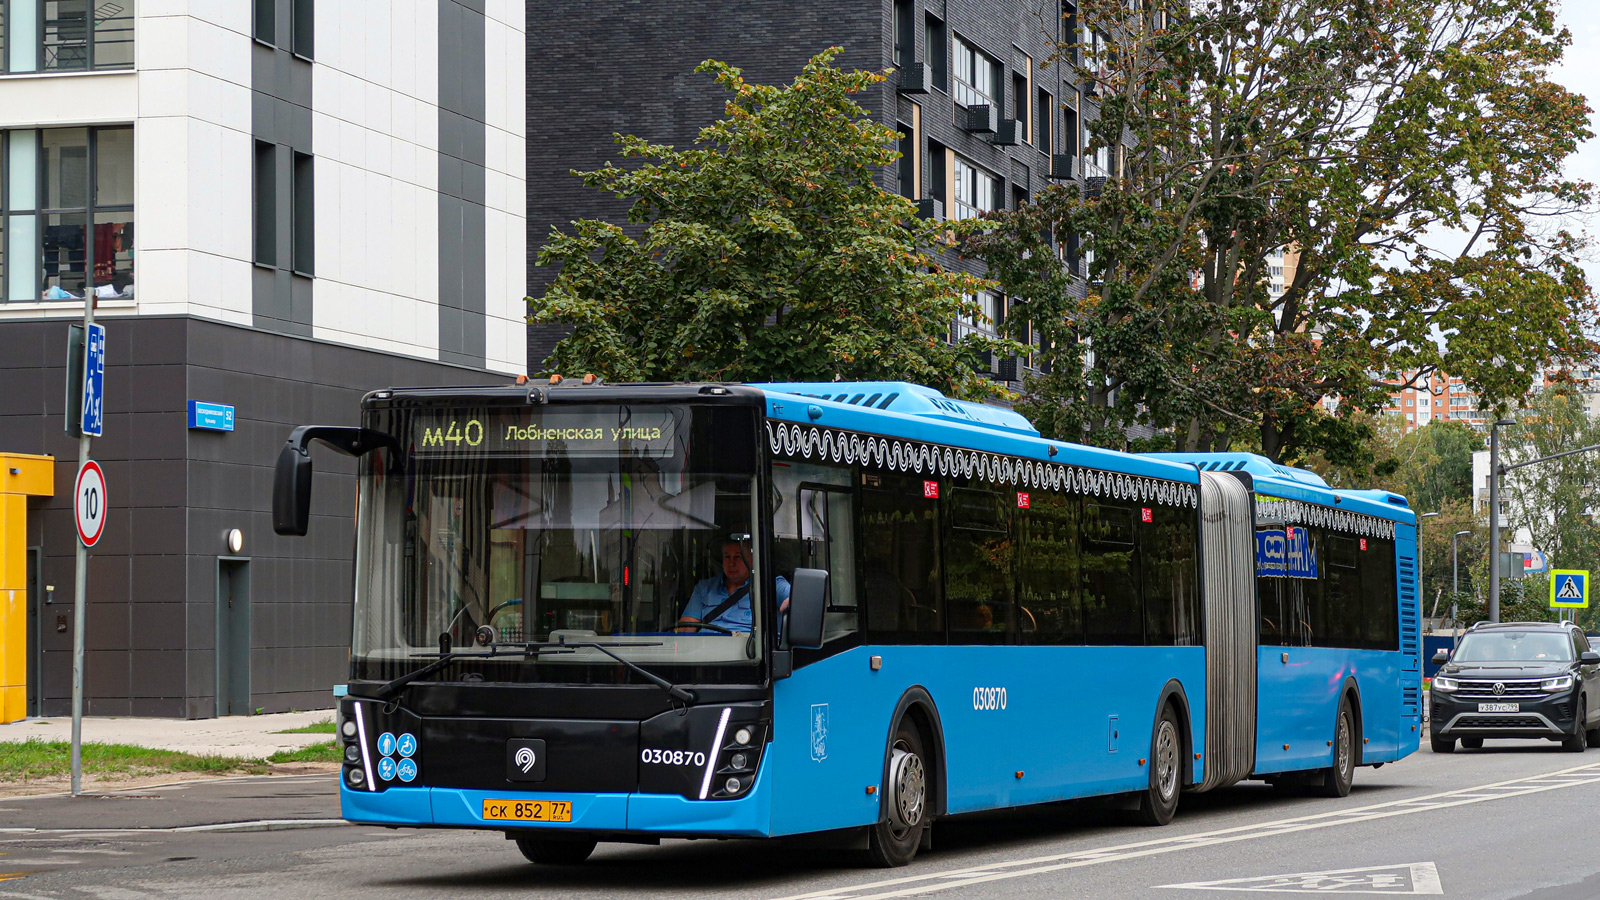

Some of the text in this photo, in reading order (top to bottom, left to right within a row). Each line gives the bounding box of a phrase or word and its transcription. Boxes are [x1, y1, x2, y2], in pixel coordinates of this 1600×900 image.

[225, 410, 232, 421] 52
[504, 423, 603, 441] Лобненская
[610, 426, 661, 441] улица
[84, 487, 98, 520] 10
[973, 686, 1007, 711] 030870
[641, 748, 705, 767] 030870
[514, 802, 543, 819] 852
[551, 802, 567, 815] 77
